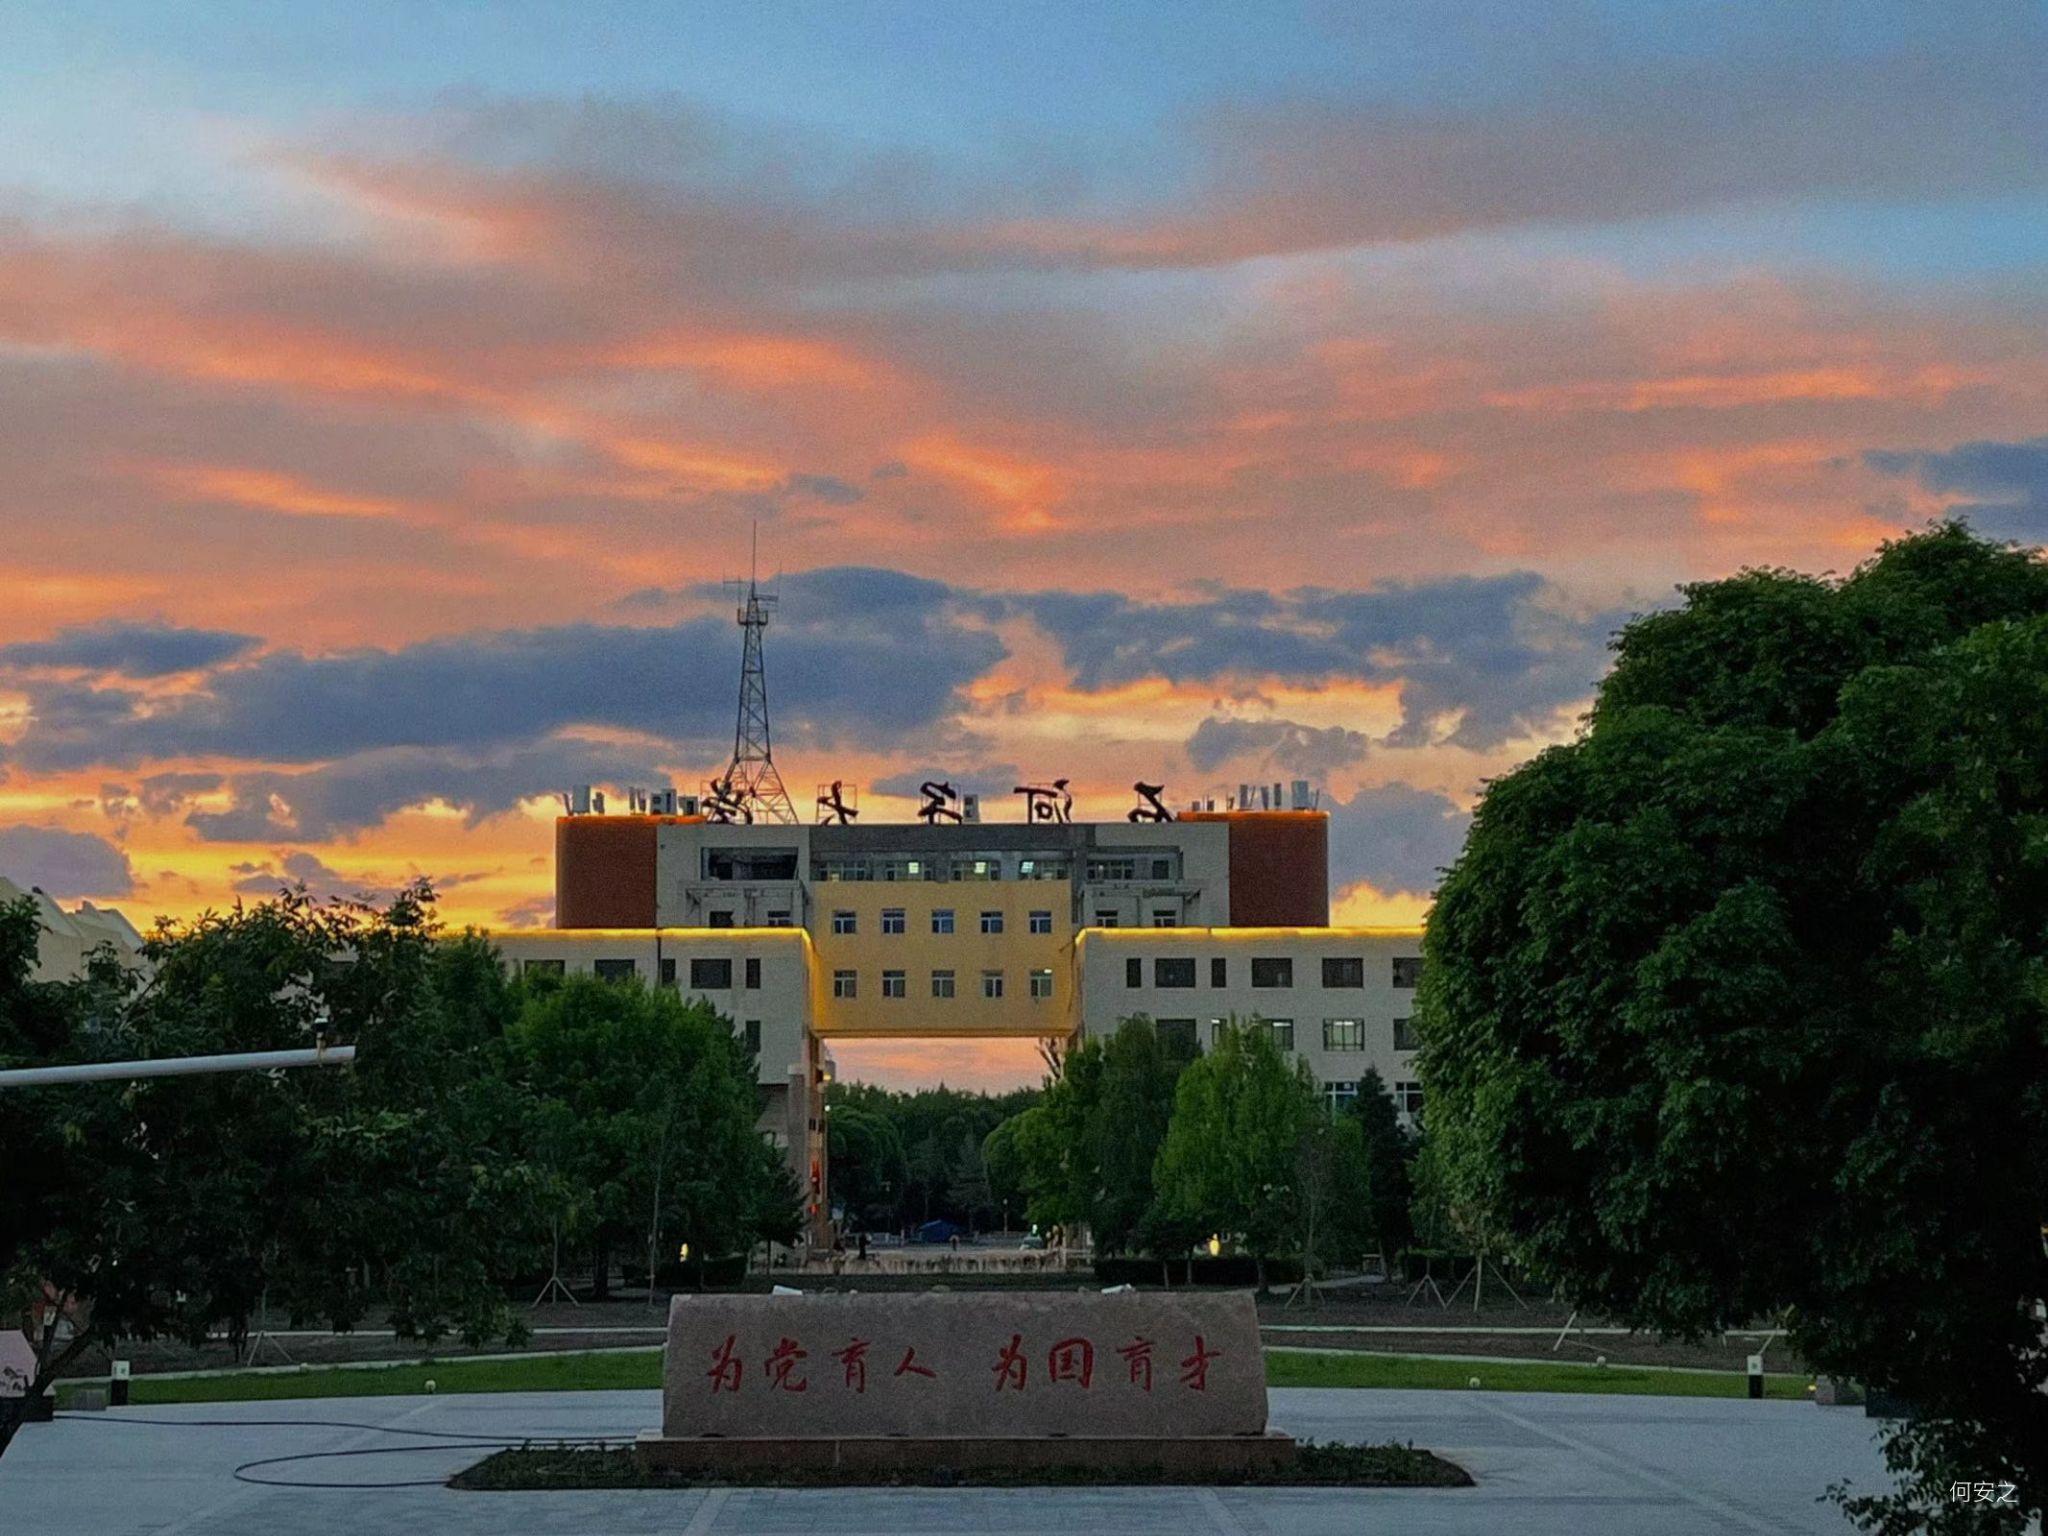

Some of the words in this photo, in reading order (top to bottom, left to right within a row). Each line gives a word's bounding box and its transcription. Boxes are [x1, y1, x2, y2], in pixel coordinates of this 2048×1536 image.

[706, 1335, 936, 1394] 为党育人
[991, 1334, 1222, 1392] 为国育才
